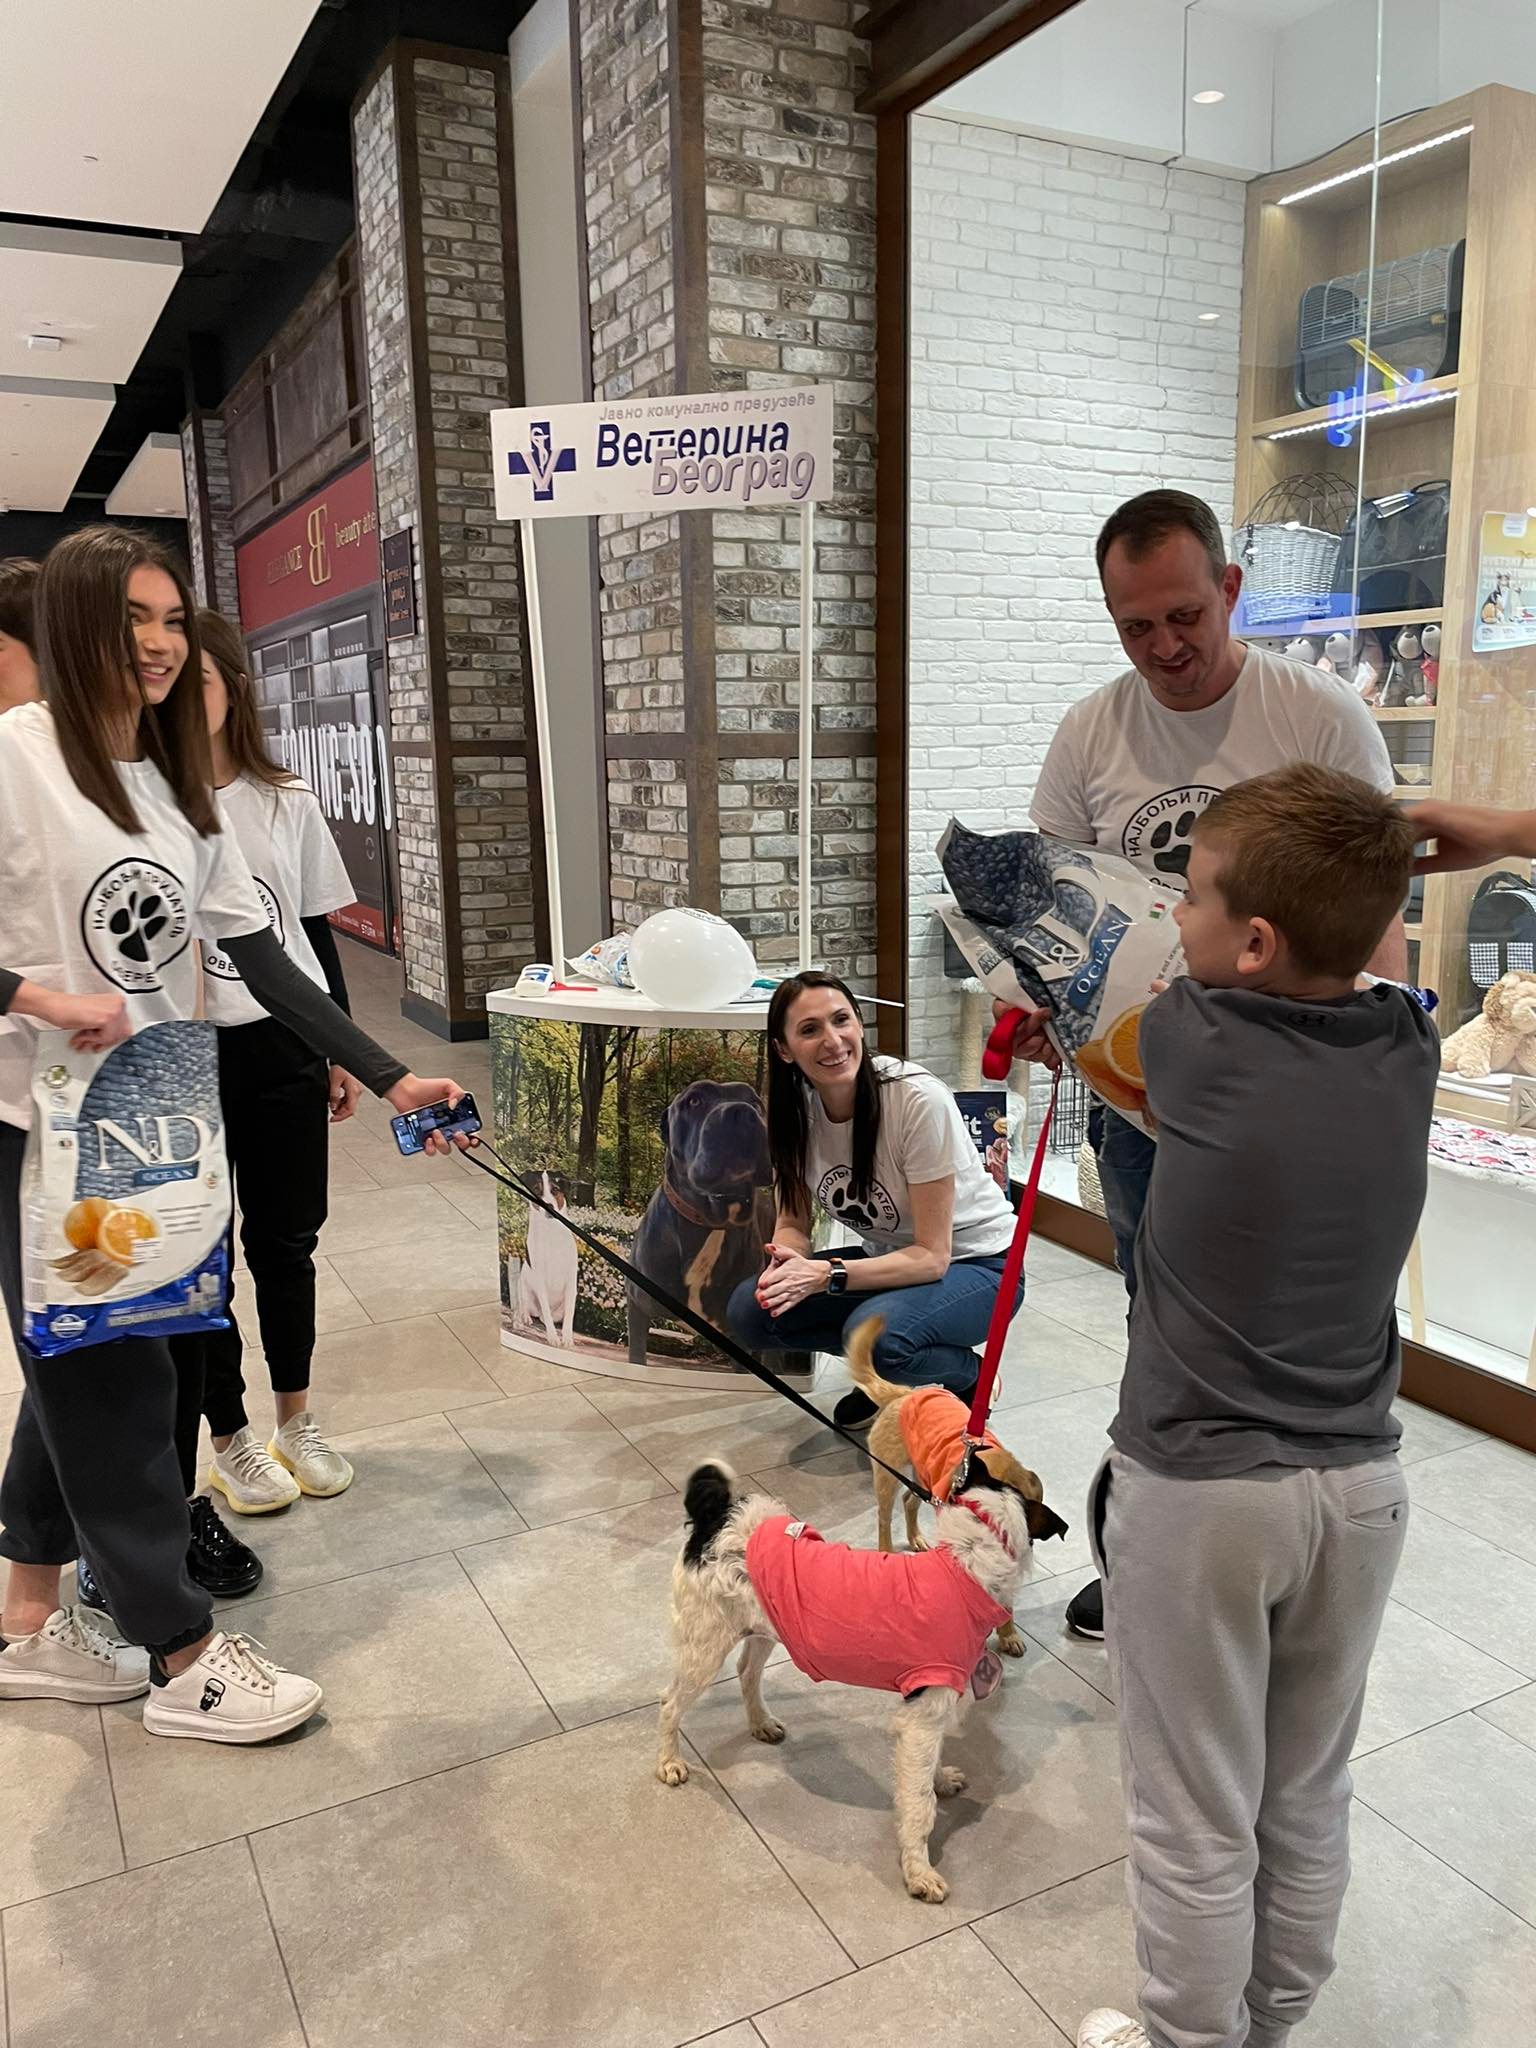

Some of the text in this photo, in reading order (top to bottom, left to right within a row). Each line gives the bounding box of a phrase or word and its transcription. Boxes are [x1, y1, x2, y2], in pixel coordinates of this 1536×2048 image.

[600, 393, 816, 421] Јавно комунално предузеће
[596, 421, 789, 468] Ветерина
[652, 450, 816, 501] Београд
[1127, 791, 1191, 858] НАЈБОЉИ
[1076, 917, 1135, 993] OCEAN
